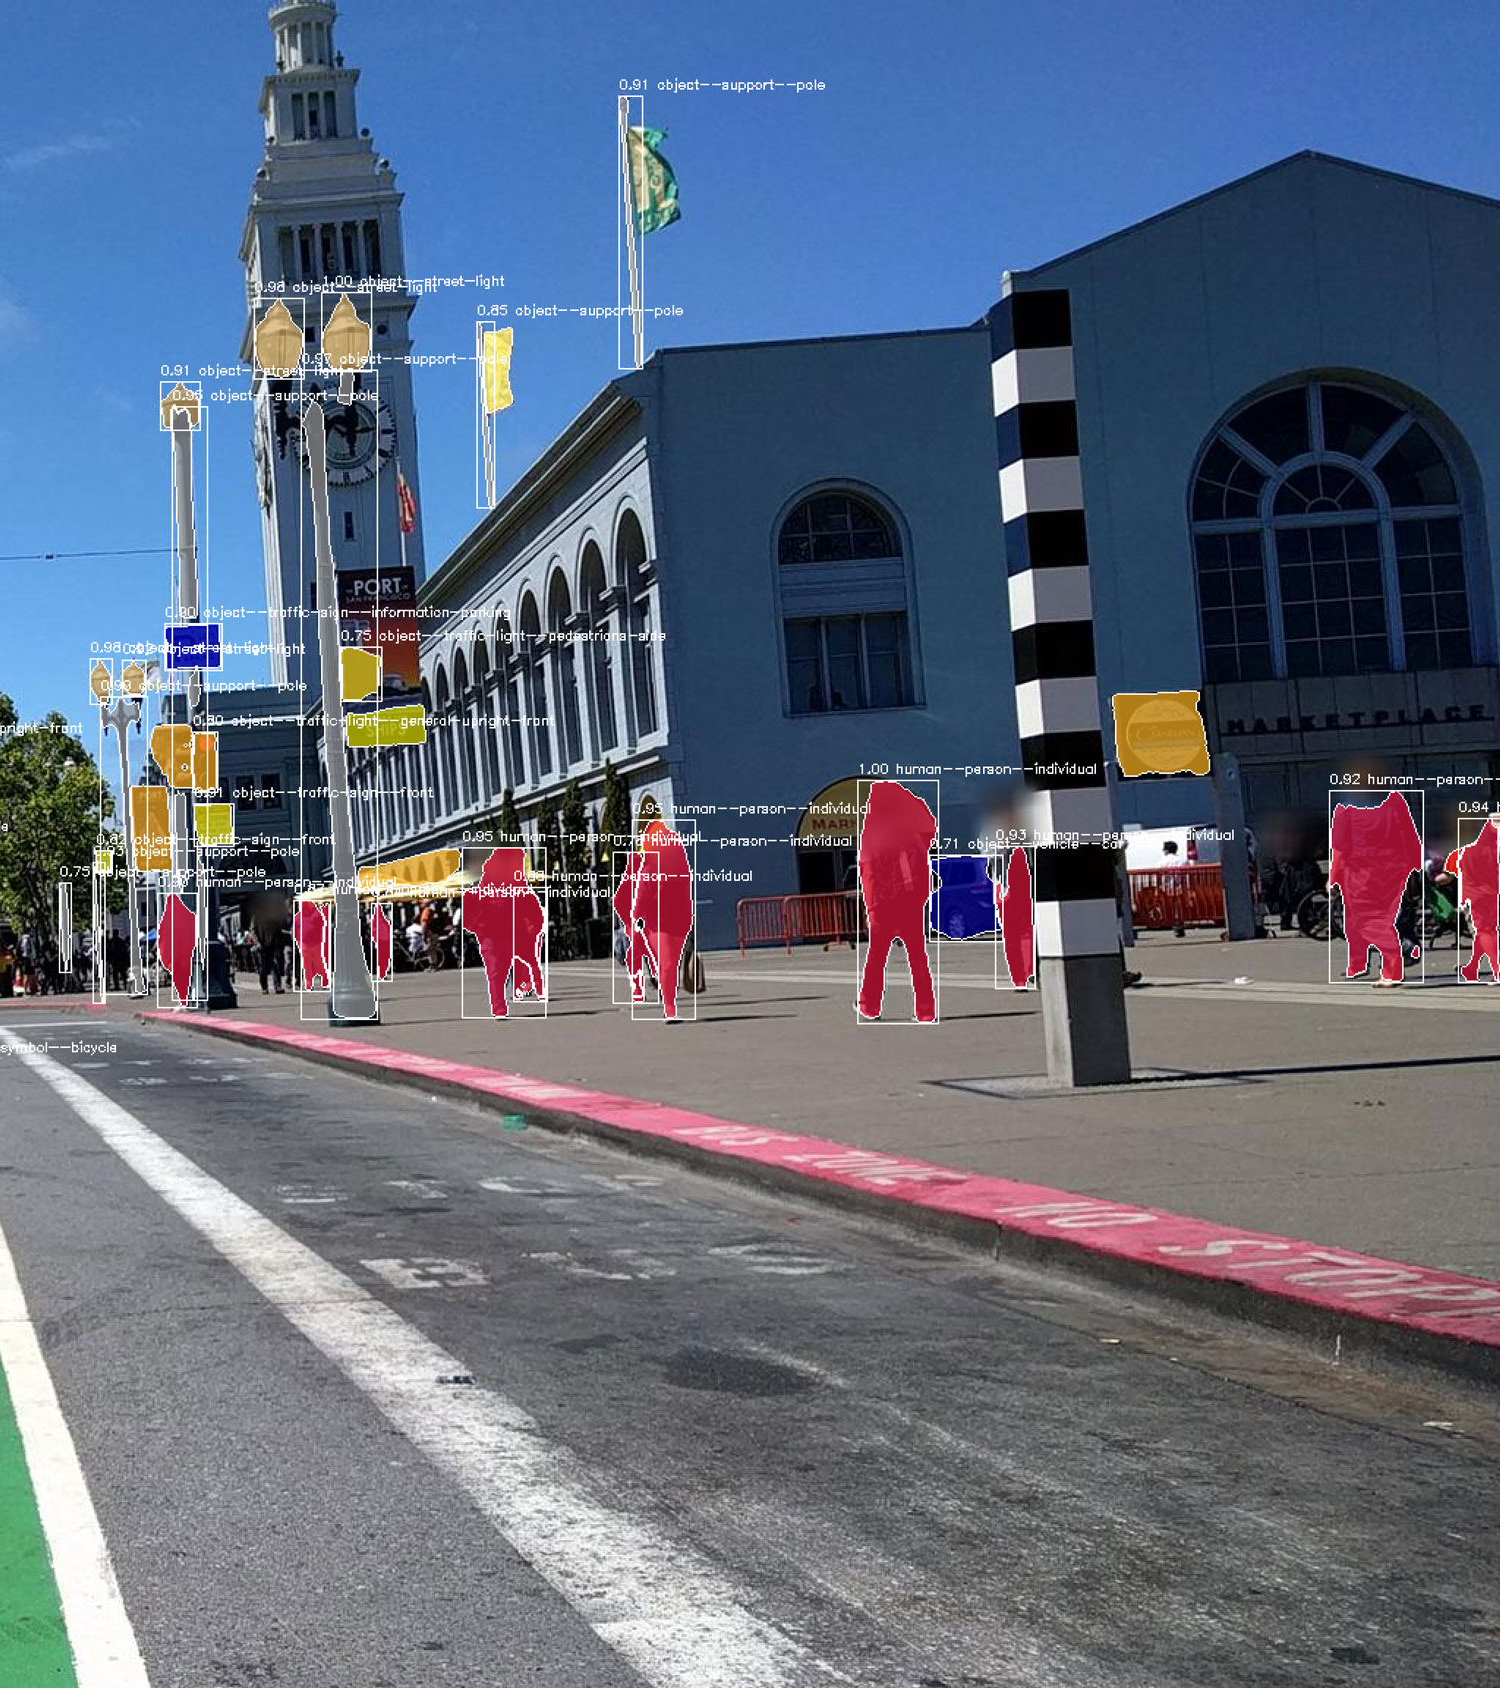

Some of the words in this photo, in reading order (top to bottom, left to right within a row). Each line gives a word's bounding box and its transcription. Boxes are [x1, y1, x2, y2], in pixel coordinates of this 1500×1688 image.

[353, 577, 402, 596] PORT
[1226, 704, 1488, 734] MARKETPLACE
[993, 1202, 1160, 1229] NO
